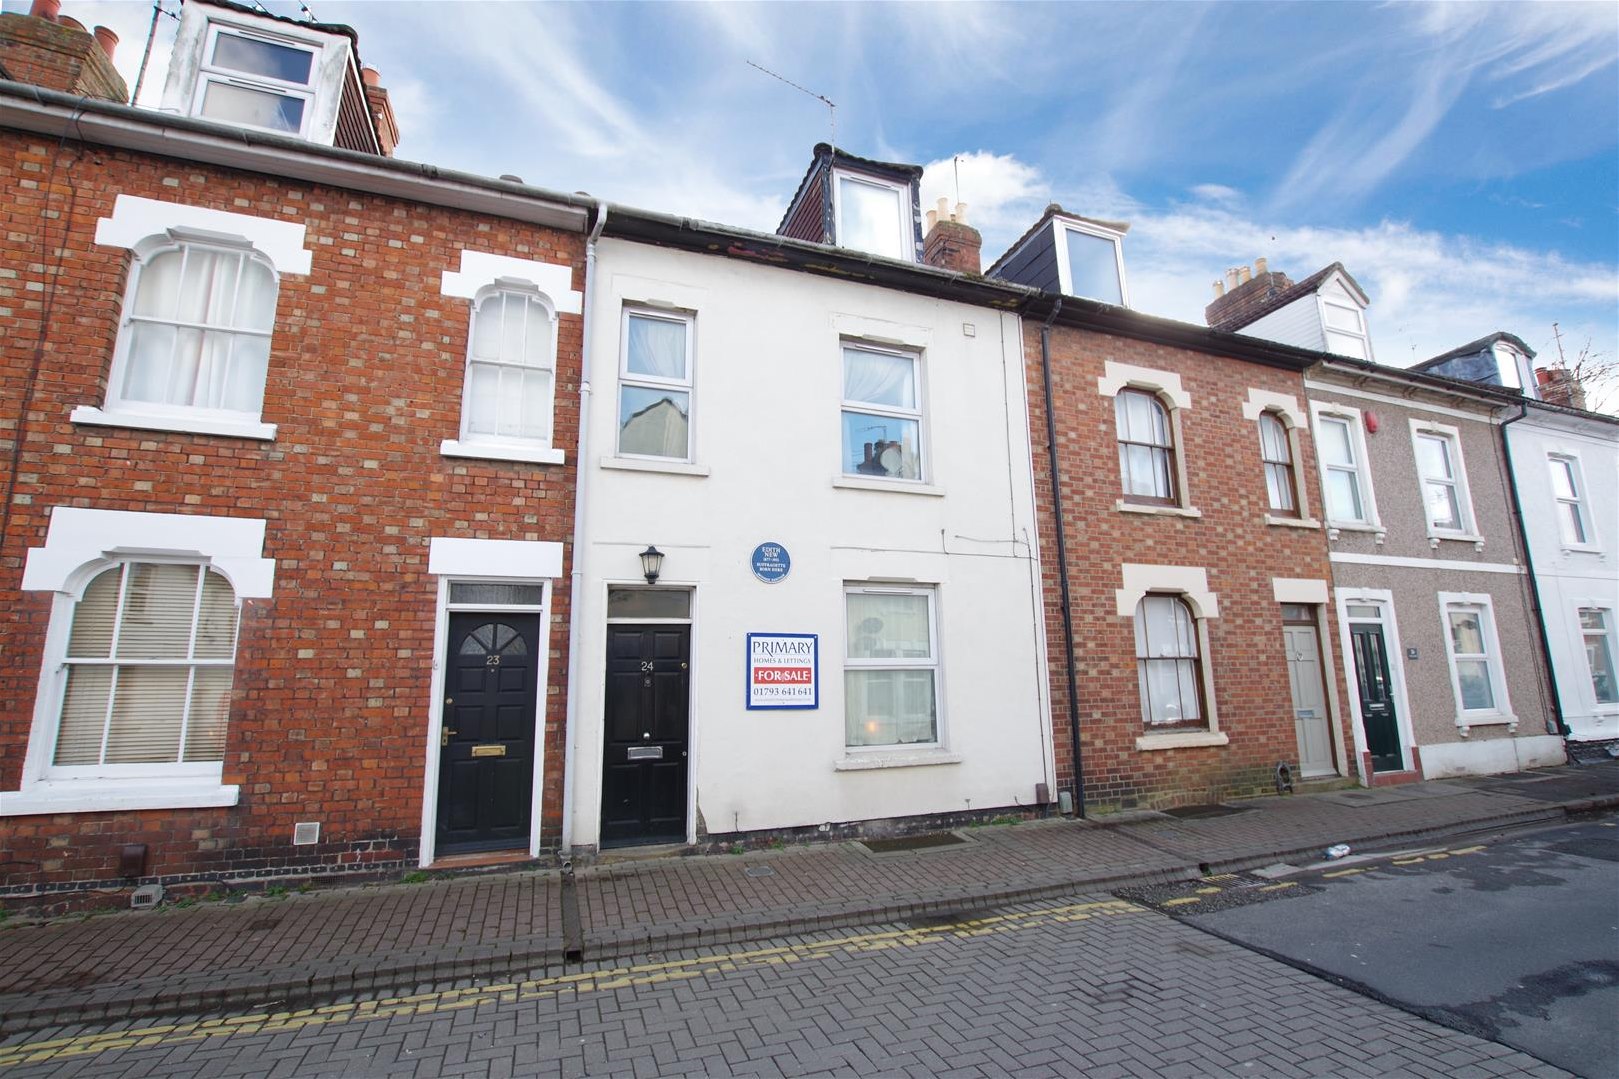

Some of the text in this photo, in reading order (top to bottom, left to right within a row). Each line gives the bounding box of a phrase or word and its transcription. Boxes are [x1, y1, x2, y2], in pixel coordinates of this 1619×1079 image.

[753, 641, 812, 657] PRIMARY
[486, 655, 500, 665] 23
[641, 661, 654, 671] 24
[758, 670, 808, 681] FOR SALE
[753, 688, 779, 696] 01793
